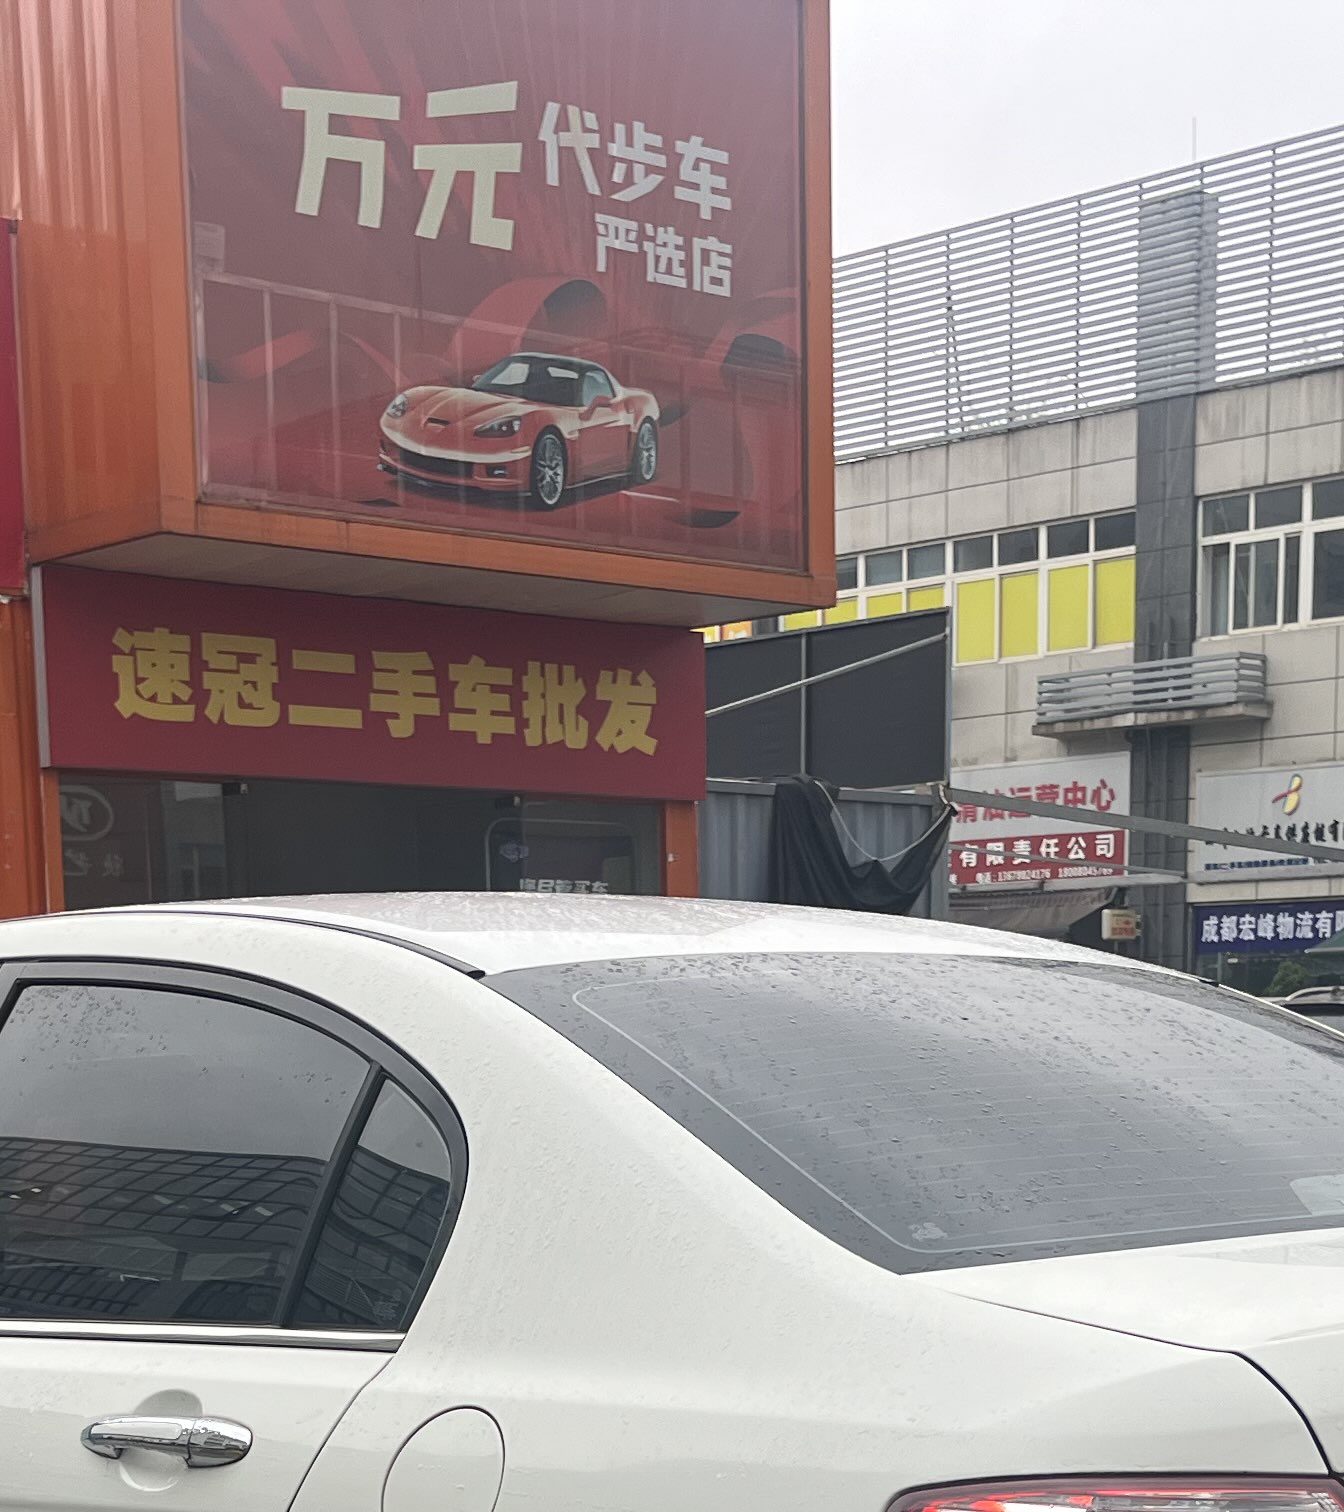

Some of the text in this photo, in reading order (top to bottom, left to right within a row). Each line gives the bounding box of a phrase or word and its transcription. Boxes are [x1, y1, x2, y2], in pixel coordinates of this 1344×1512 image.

[281, 80, 523, 252] 万元
[537, 101, 733, 221] 代步车
[593, 211, 733, 298] 严选店
[111, 625, 659, 756] 速冠二手车批发
[948, 833, 1116, 868] 有限责任公司
